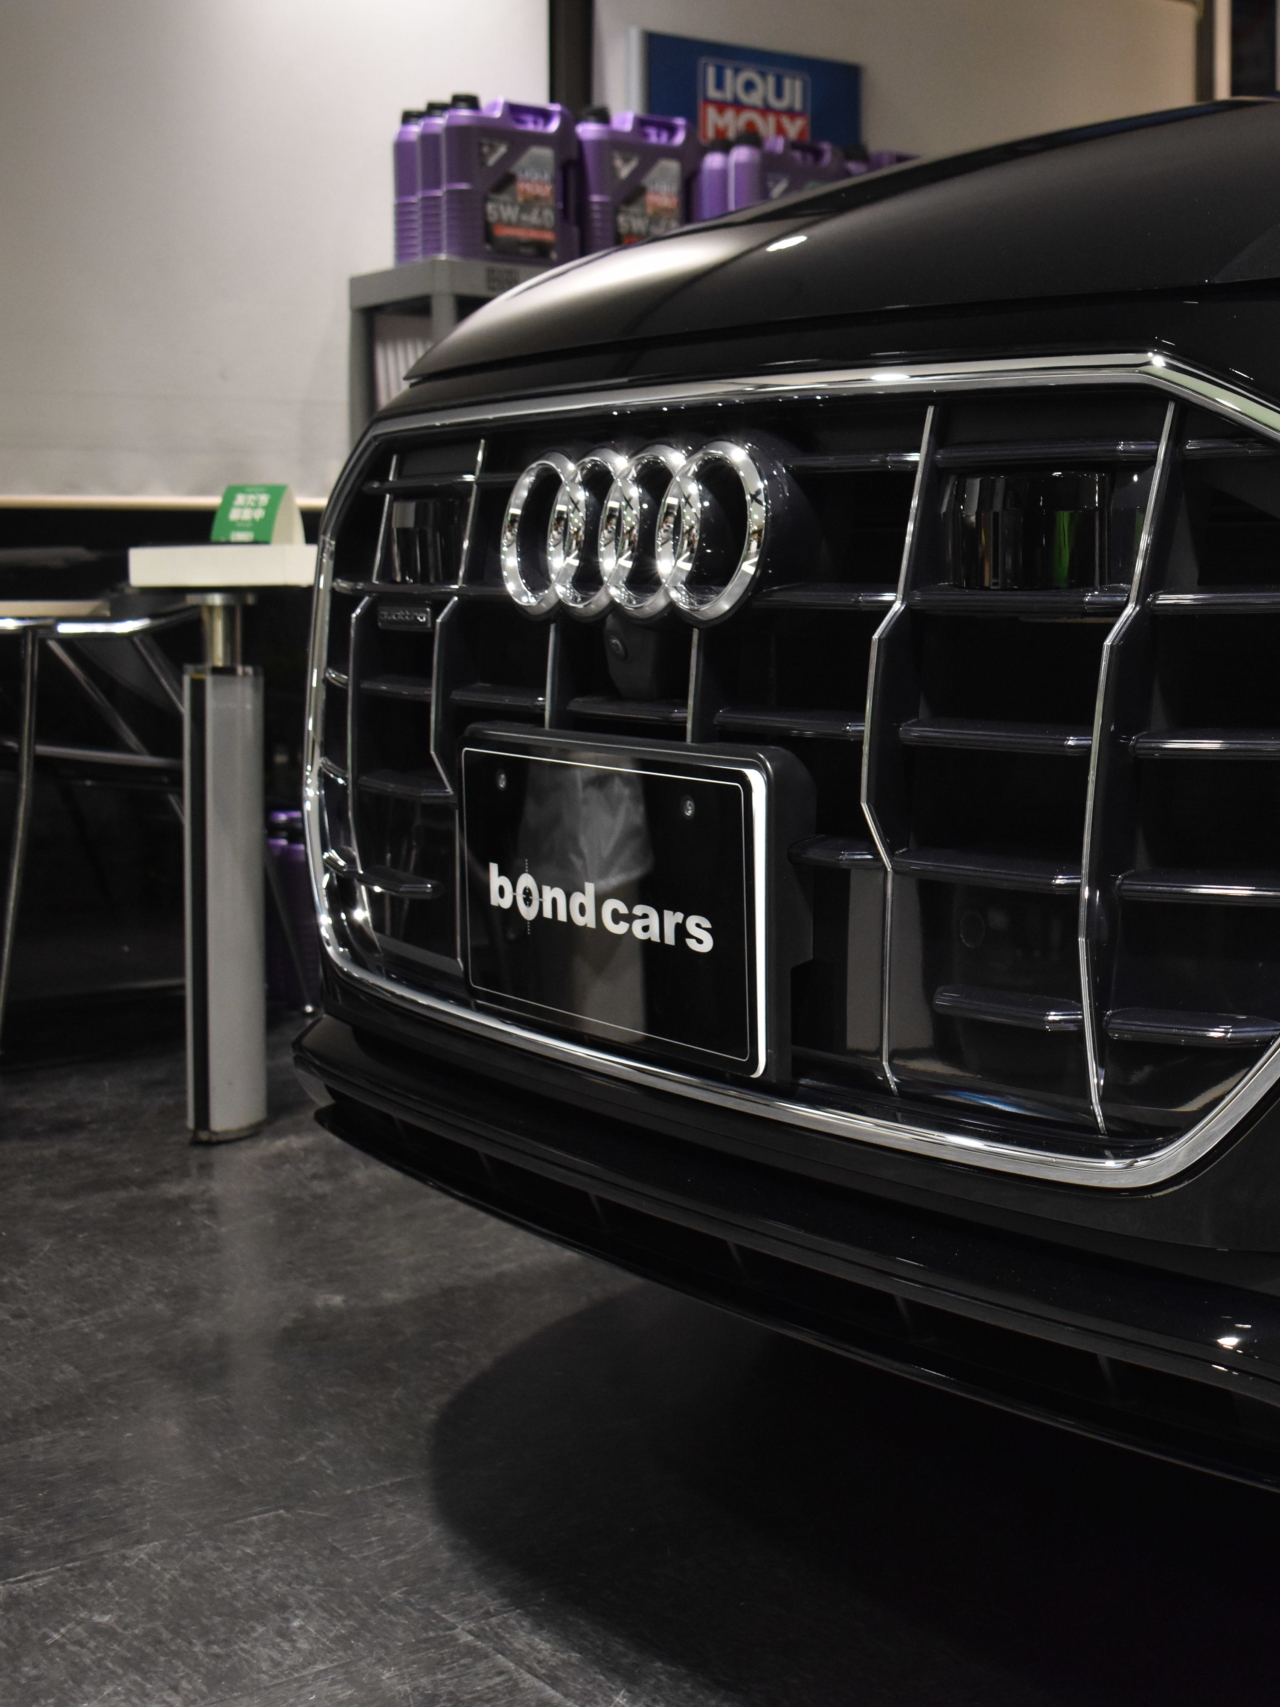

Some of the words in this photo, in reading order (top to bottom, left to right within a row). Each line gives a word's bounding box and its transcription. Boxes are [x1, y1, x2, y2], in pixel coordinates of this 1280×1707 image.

[706, 64, 803, 112] LIQUI
[706, 104, 807, 141] MOLY
[486, 202, 555, 229] 5W-40
